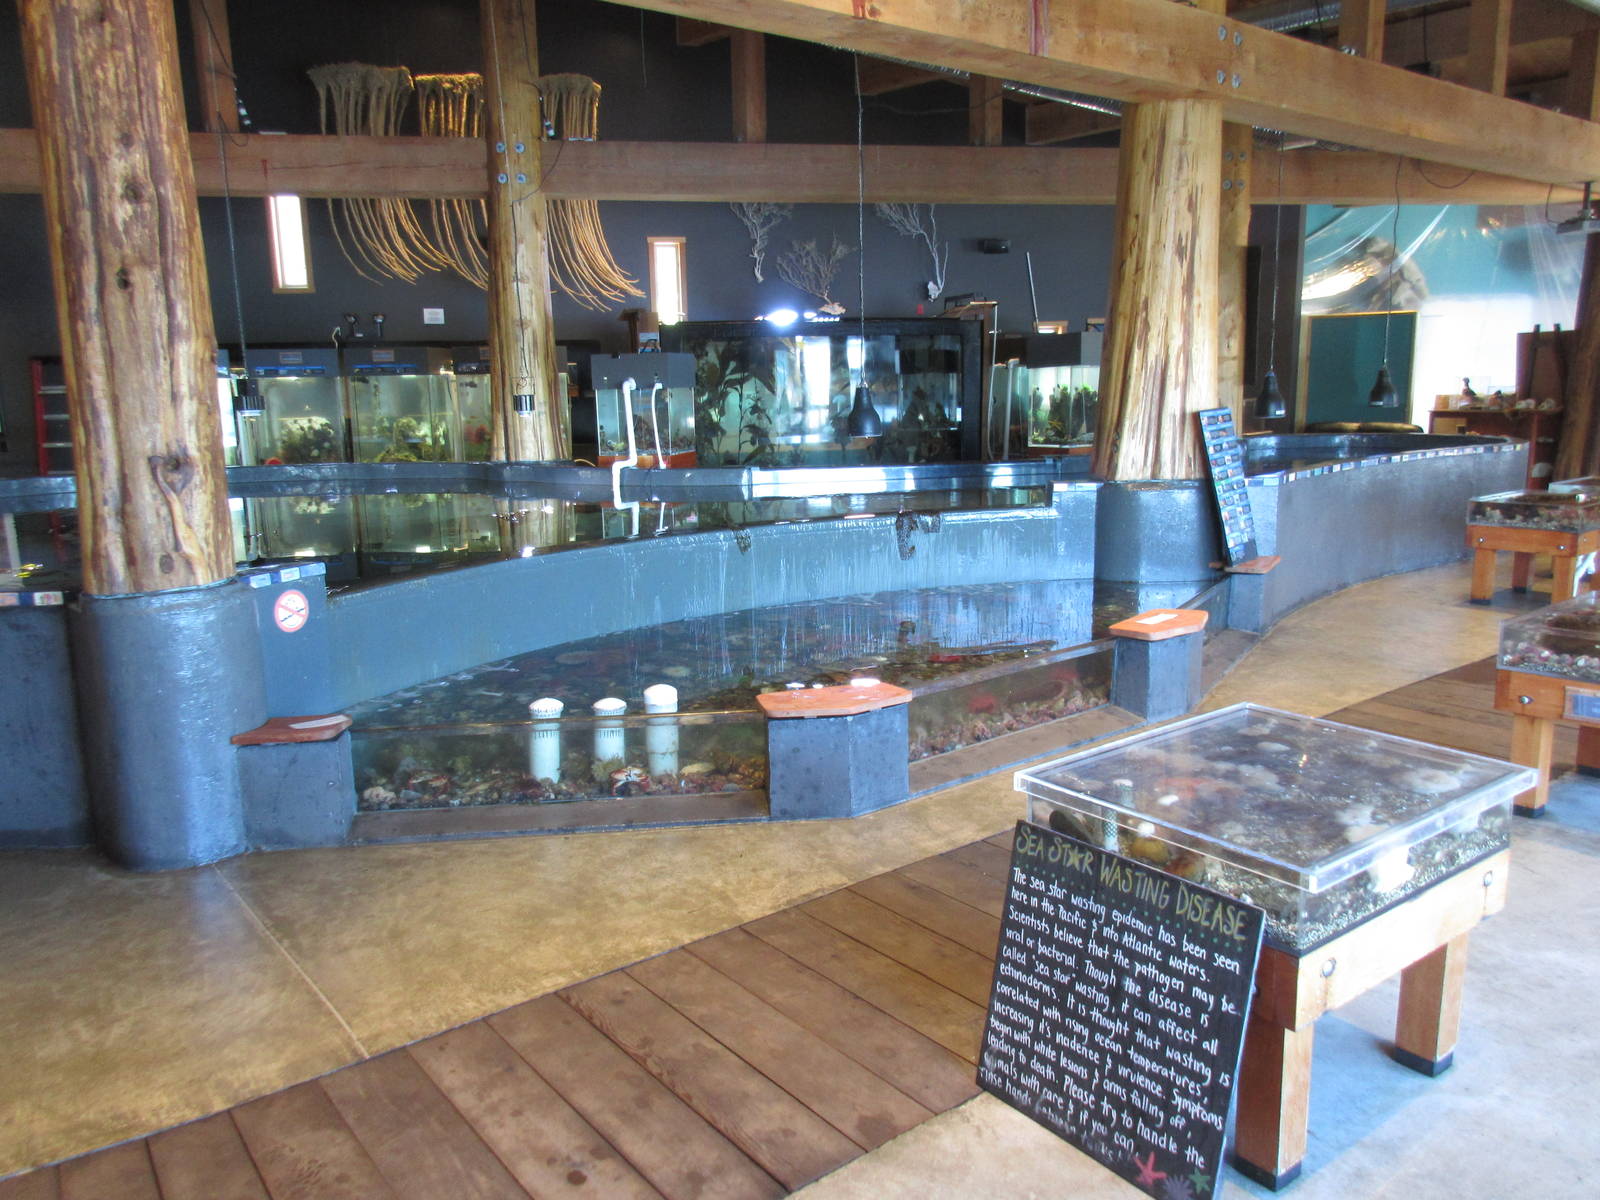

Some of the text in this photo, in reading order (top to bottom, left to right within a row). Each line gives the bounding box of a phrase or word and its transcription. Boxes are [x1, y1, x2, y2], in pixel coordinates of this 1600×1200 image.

[1011, 885, 1027, 904] here
[1030, 895, 1038, 908] in
[1041, 897, 1055, 916] the
[1058, 904, 1087, 929] Pacific
[1103, 924, 1119, 942] into
[1122, 931, 1162, 961] Atlantic
[1013, 867, 1240, 975] The sea star wasting epidemic has been seen
[1016, 825, 1045, 860] SEA
[1100, 854, 1170, 910] WASTING
[1176, 881, 1249, 940] DISEASE
[1002, 945, 1026, 965] called
[1121, 997, 1129, 1014] it
[1134, 1007, 1151, 1025] can
[1158, 1018, 1197, 1044] affect
[1202, 1039, 1218, 1056] all
[1006, 928, 1209, 1028] viral or bacterial. Though the disease is
[1009, 905, 1240, 1015] Scientists believe that the pathogen may be
[990, 1014, 1012, 1037] begin
[1014, 1030, 1030, 1048] with
[1034, 1040, 1056, 1061] white
[1060, 1050, 1088, 1079] lesions
[1103, 1078, 1126, 1101] arms
[1130, 1089, 1164, 1128] falling
[994, 1000, 1034, 1033] increasing
[1039, 1018, 1051, 1038] it's
[1056, 1031, 1099, 1064] incidence
[1118, 1064, 1166, 1099] virulence.
[1171, 1089, 1222, 1131] Symptoms
[997, 981, 1040, 1010] correlated
[1043, 1005, 1060, 1022] with
[1065, 1018, 1089, 1044] rising
[1095, 1032, 1122, 1054] ocean
[1000, 963, 1230, 1087] echinoderms. It is thought that wasting is
[988, 1030, 1015, 1064] leading
[1019, 1049, 1026, 1064] to
[1064, 1074, 1095, 1108] Please
[1100, 1095, 1117, 1128] try
[1121, 1108, 1133, 1129] to
[1137, 1117, 1177, 1154] handle
[1185, 1145, 1205, 1168] the
[1020, 1073, 1040, 1094] with
[1043, 1087, 1063, 1109] care
[1080, 1110, 1088, 1125] if
[1091, 1118, 1107, 1136] you
